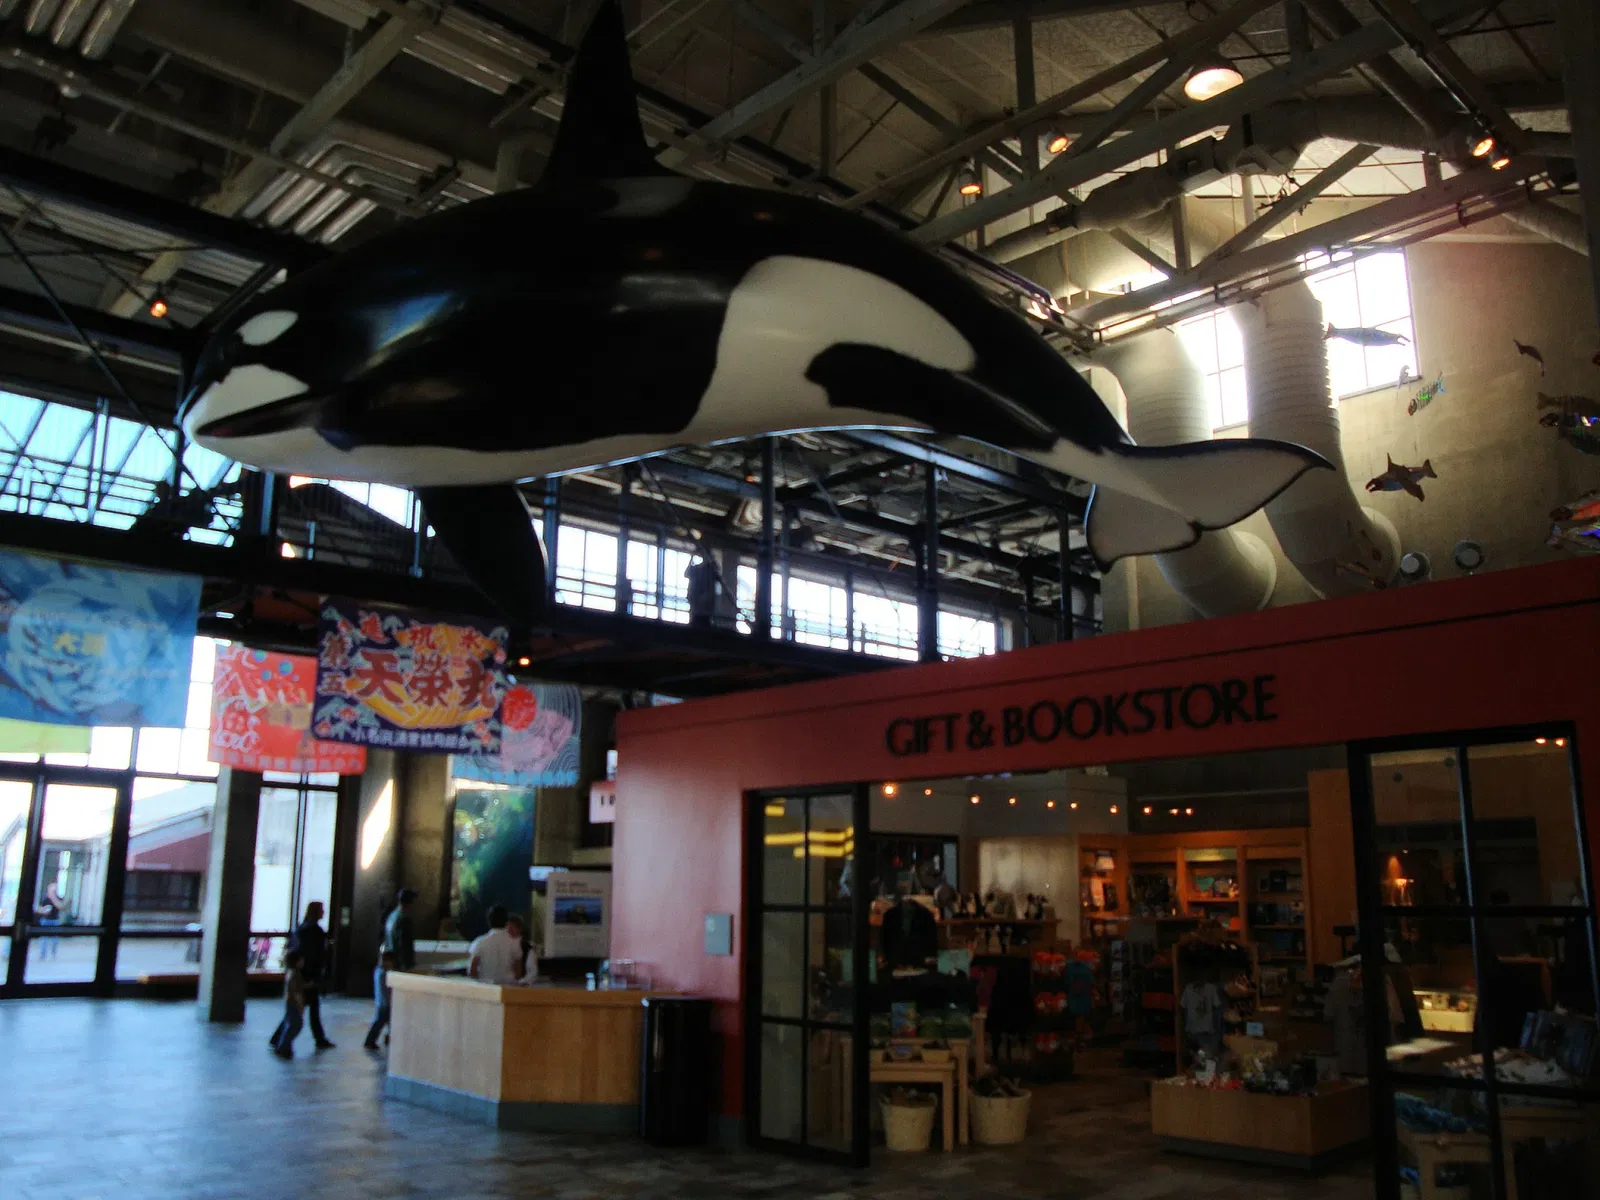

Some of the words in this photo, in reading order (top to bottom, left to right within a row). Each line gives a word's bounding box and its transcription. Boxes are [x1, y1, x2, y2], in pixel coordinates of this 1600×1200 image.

[888, 713, 961, 757] GIFT
[966, 709, 996, 749] &
[1003, 674, 1279, 747] BOOKSTORE
